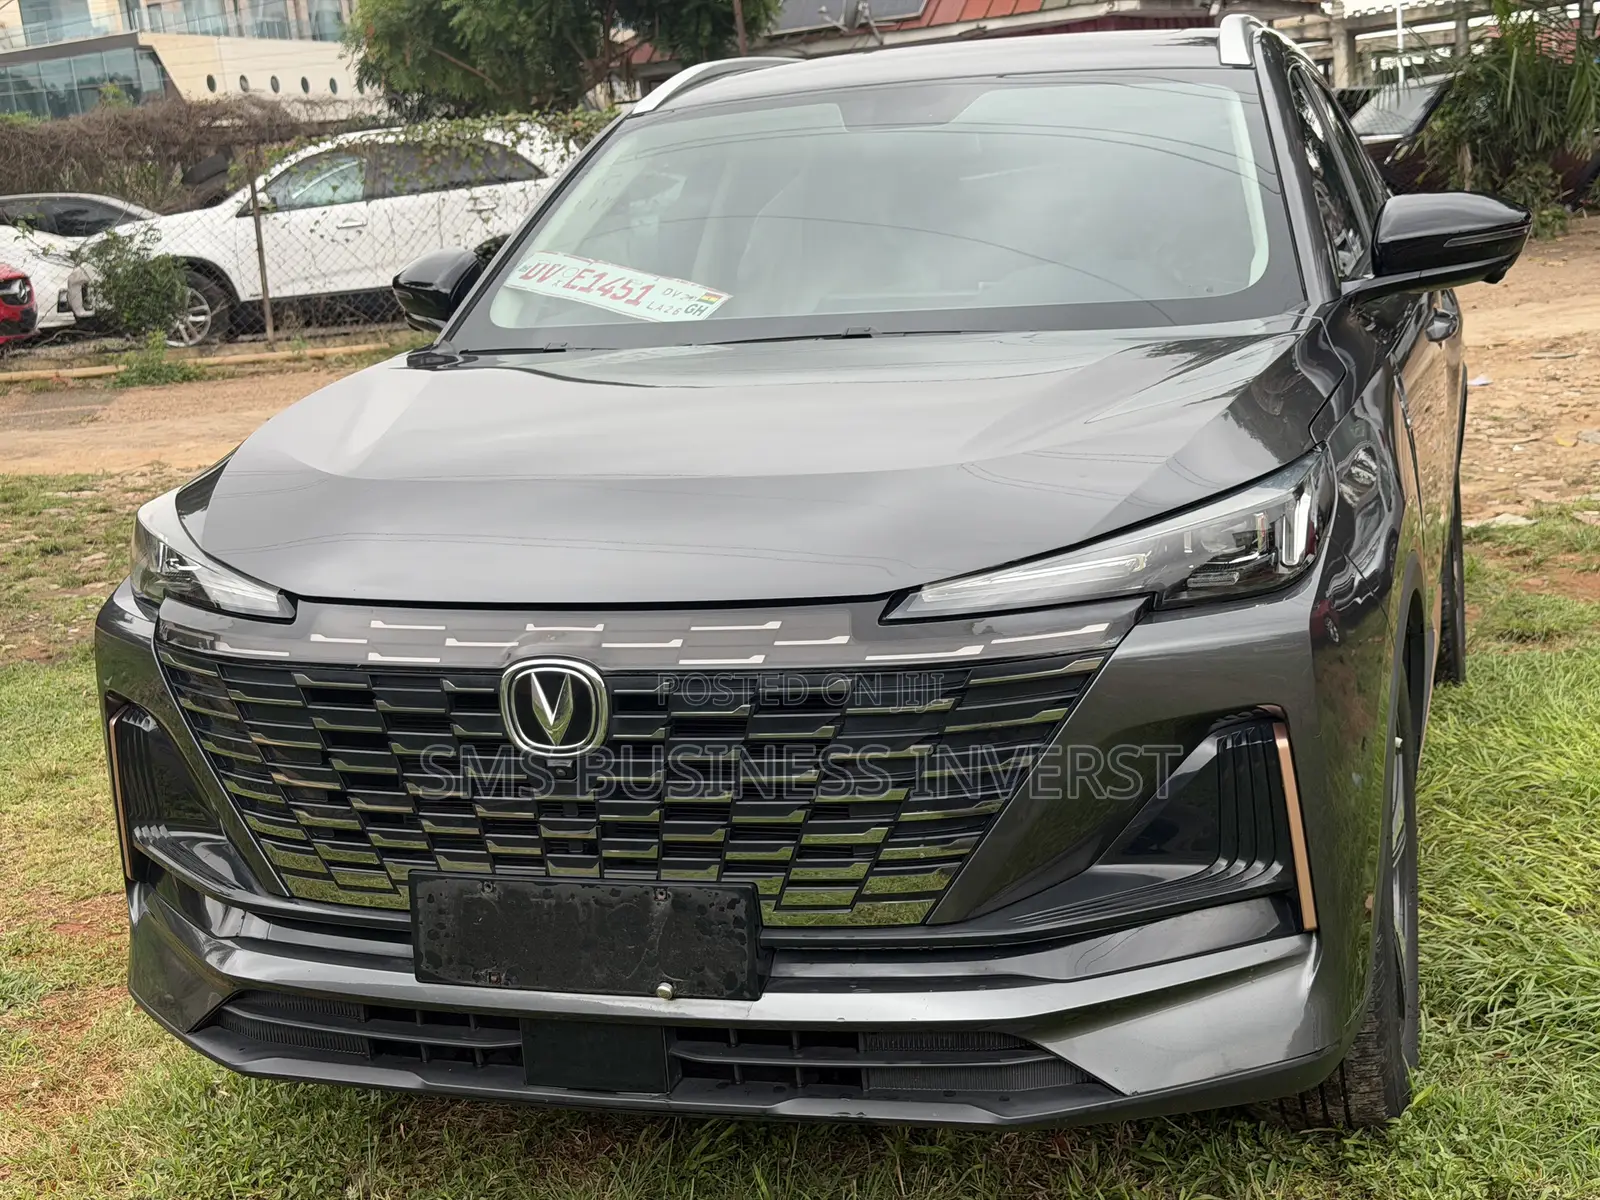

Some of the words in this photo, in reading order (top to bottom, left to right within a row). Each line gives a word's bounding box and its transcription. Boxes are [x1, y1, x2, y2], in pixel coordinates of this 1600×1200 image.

[519, 262, 566, 283] DV
[562, 268, 655, 306] E1451
[684, 303, 709, 317] GH
